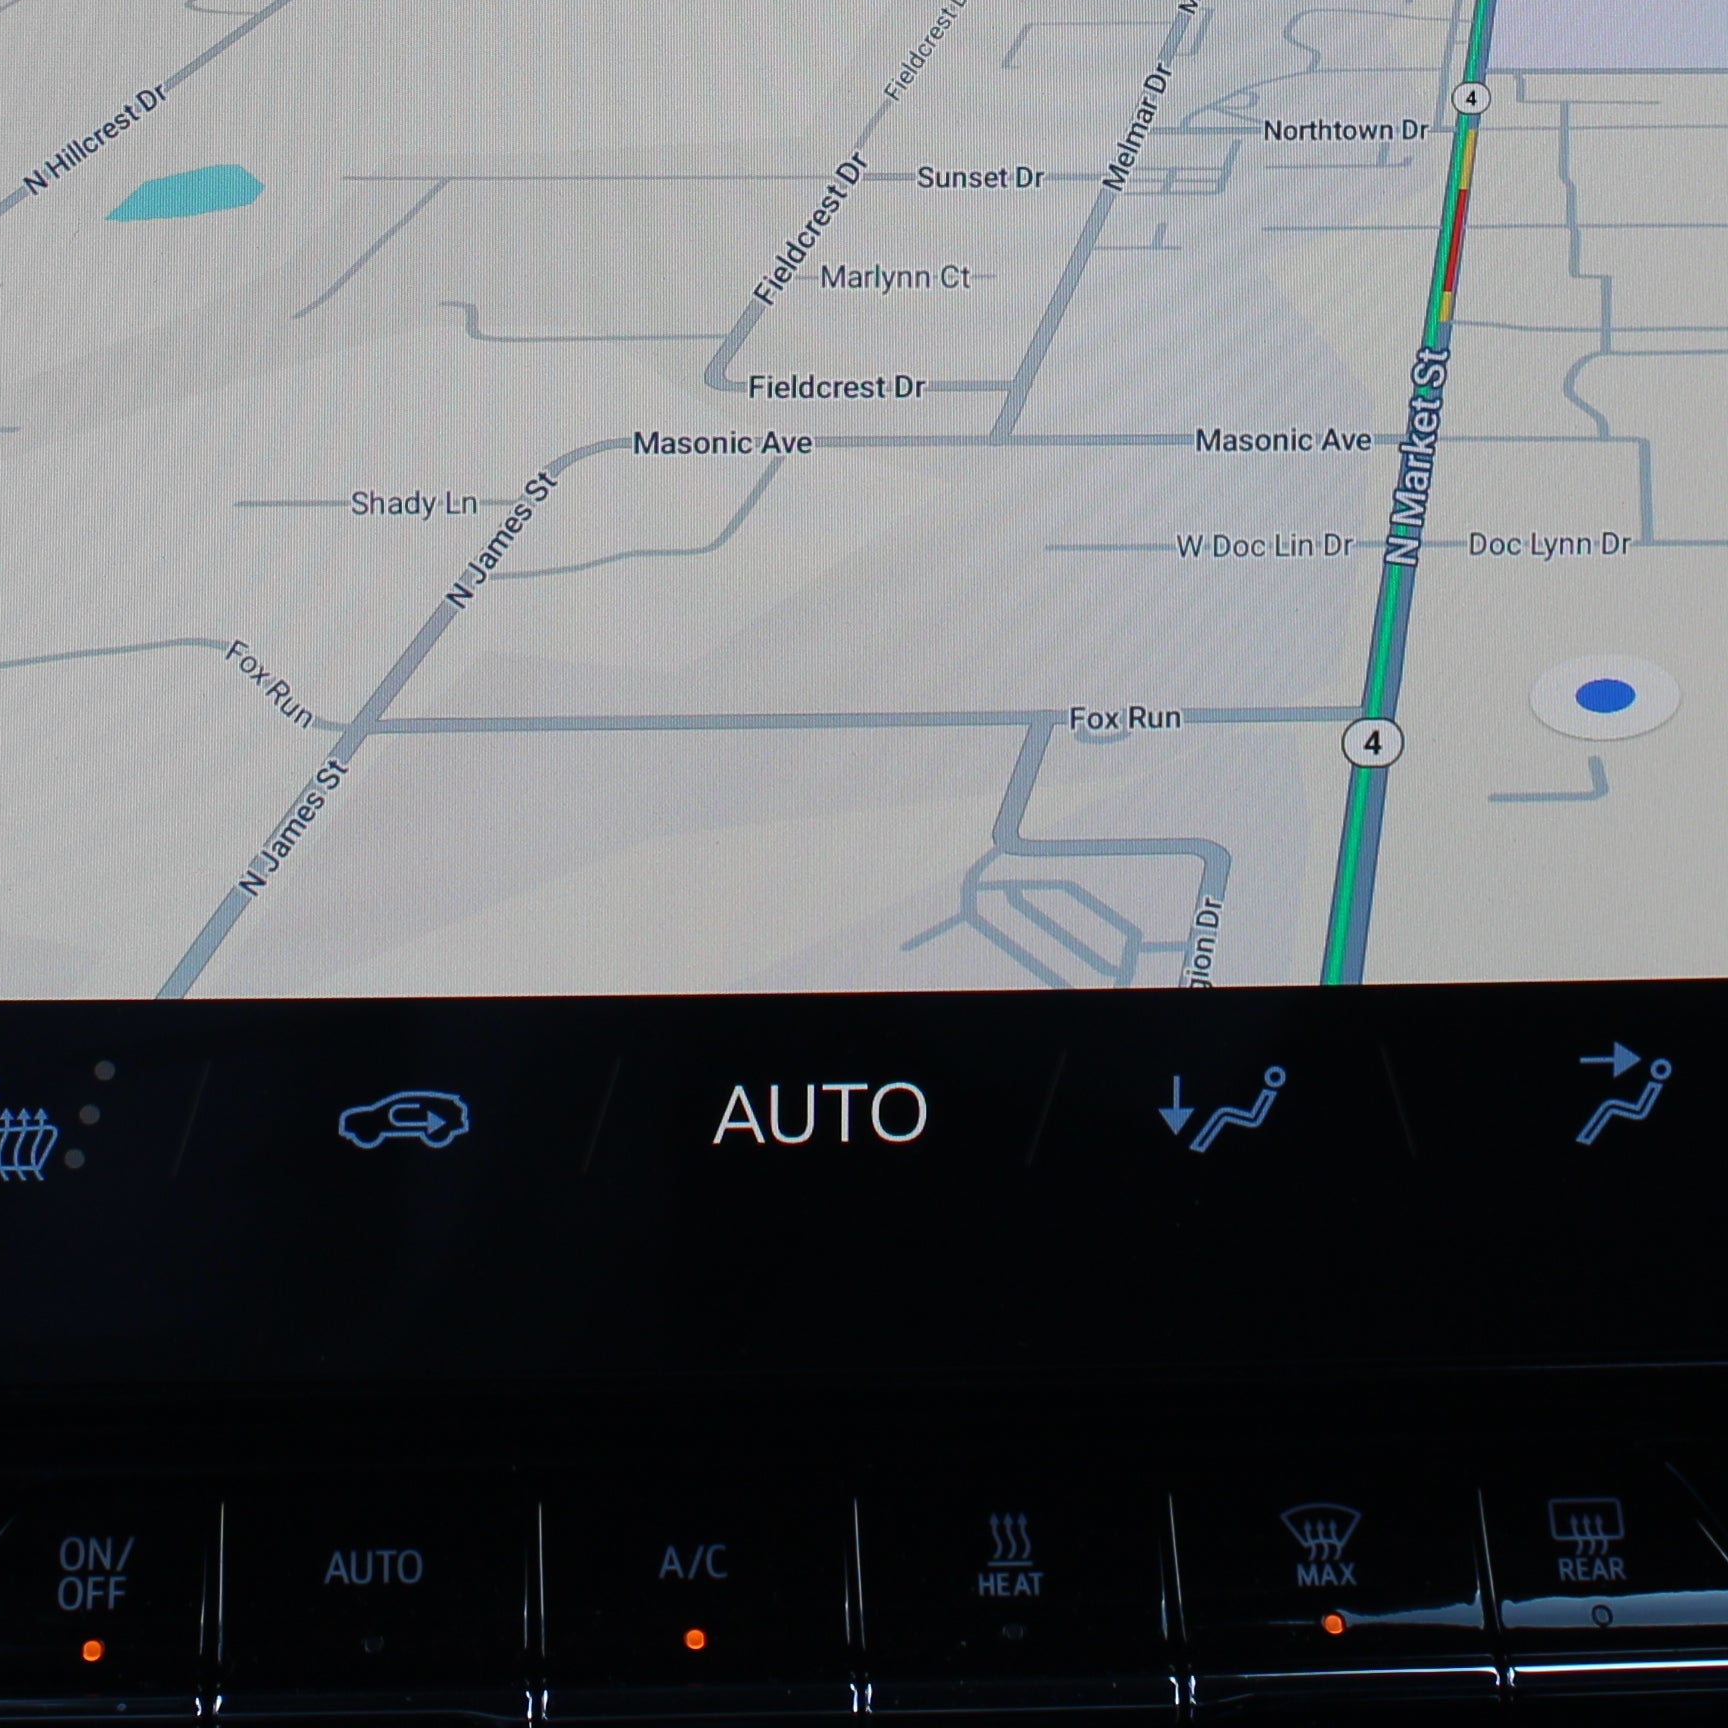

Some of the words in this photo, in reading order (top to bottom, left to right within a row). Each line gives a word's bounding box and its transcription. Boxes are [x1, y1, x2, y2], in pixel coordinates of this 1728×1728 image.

[883, 7, 957, 102] Fieldcrest
[1465, 90, 1477, 106] 4
[22, 168, 49, 196] N
[43, 105, 137, 179] Hillcrest
[133, 81, 167, 116] Dr
[1101, 99, 1156, 193] Melmar
[1143, 62, 1172, 96] Dr
[1264, 119, 1392, 142] Northtown
[1398, 119, 1428, 142] Dr
[917, 167, 1008, 189] Sunset
[1016, 167, 1044, 188] Dr
[752, 181, 847, 306] Fieldcrest
[834, 149, 868, 185] Dr
[821, 265, 929, 294] Marlynn
[939, 265, 970, 288] Ct
[1412, 345, 1450, 388] St
[749, 374, 885, 400] Fieldcrest
[893, 374, 926, 400] Dr
[633, 431, 753, 456] Masonic
[761, 431, 813, 456] Ave
[1195, 428, 1314, 452] Masonic
[1320, 428, 1371, 452] Ave
[1391, 394, 1445, 529] Market
[351, 491, 436, 521] Shady
[446, 491, 477, 515] Ln
[445, 583, 473, 610] N
[467, 500, 532, 586] James
[524, 469, 559, 508] St
[1177, 534, 1204, 556] W
[1212, 534, 1266, 556] Doc
[1274, 534, 1317, 556] Lin
[1325, 534, 1355, 556] Dr
[1383, 533, 1420, 567] N
[1470, 532, 1519, 556] Doc
[1527, 532, 1593, 563] Lynn
[1602, 532, 1631, 556] Dr
[225, 640, 270, 690] Fox
[265, 681, 314, 729] Run
[1070, 706, 1120, 730] Fox
[1129, 706, 1181, 730] Run
[1363, 731, 1381, 755] 4
[238, 870, 266, 896] N
[261, 787, 324, 873] James
[315, 756, 349, 792] St
[1196, 897, 1222, 928] Dr
[713, 1083, 928, 1144] AUTO
[58, 1535, 135, 1572] ON/
[323, 1549, 424, 1586] AUTO
[658, 1543, 729, 1580] A/C
[1557, 1556, 1627, 1582] REAR
[977, 1570, 1044, 1598] HEAT
[1296, 1562, 1358, 1588] MAX
[57, 1576, 127, 1611] OFF
